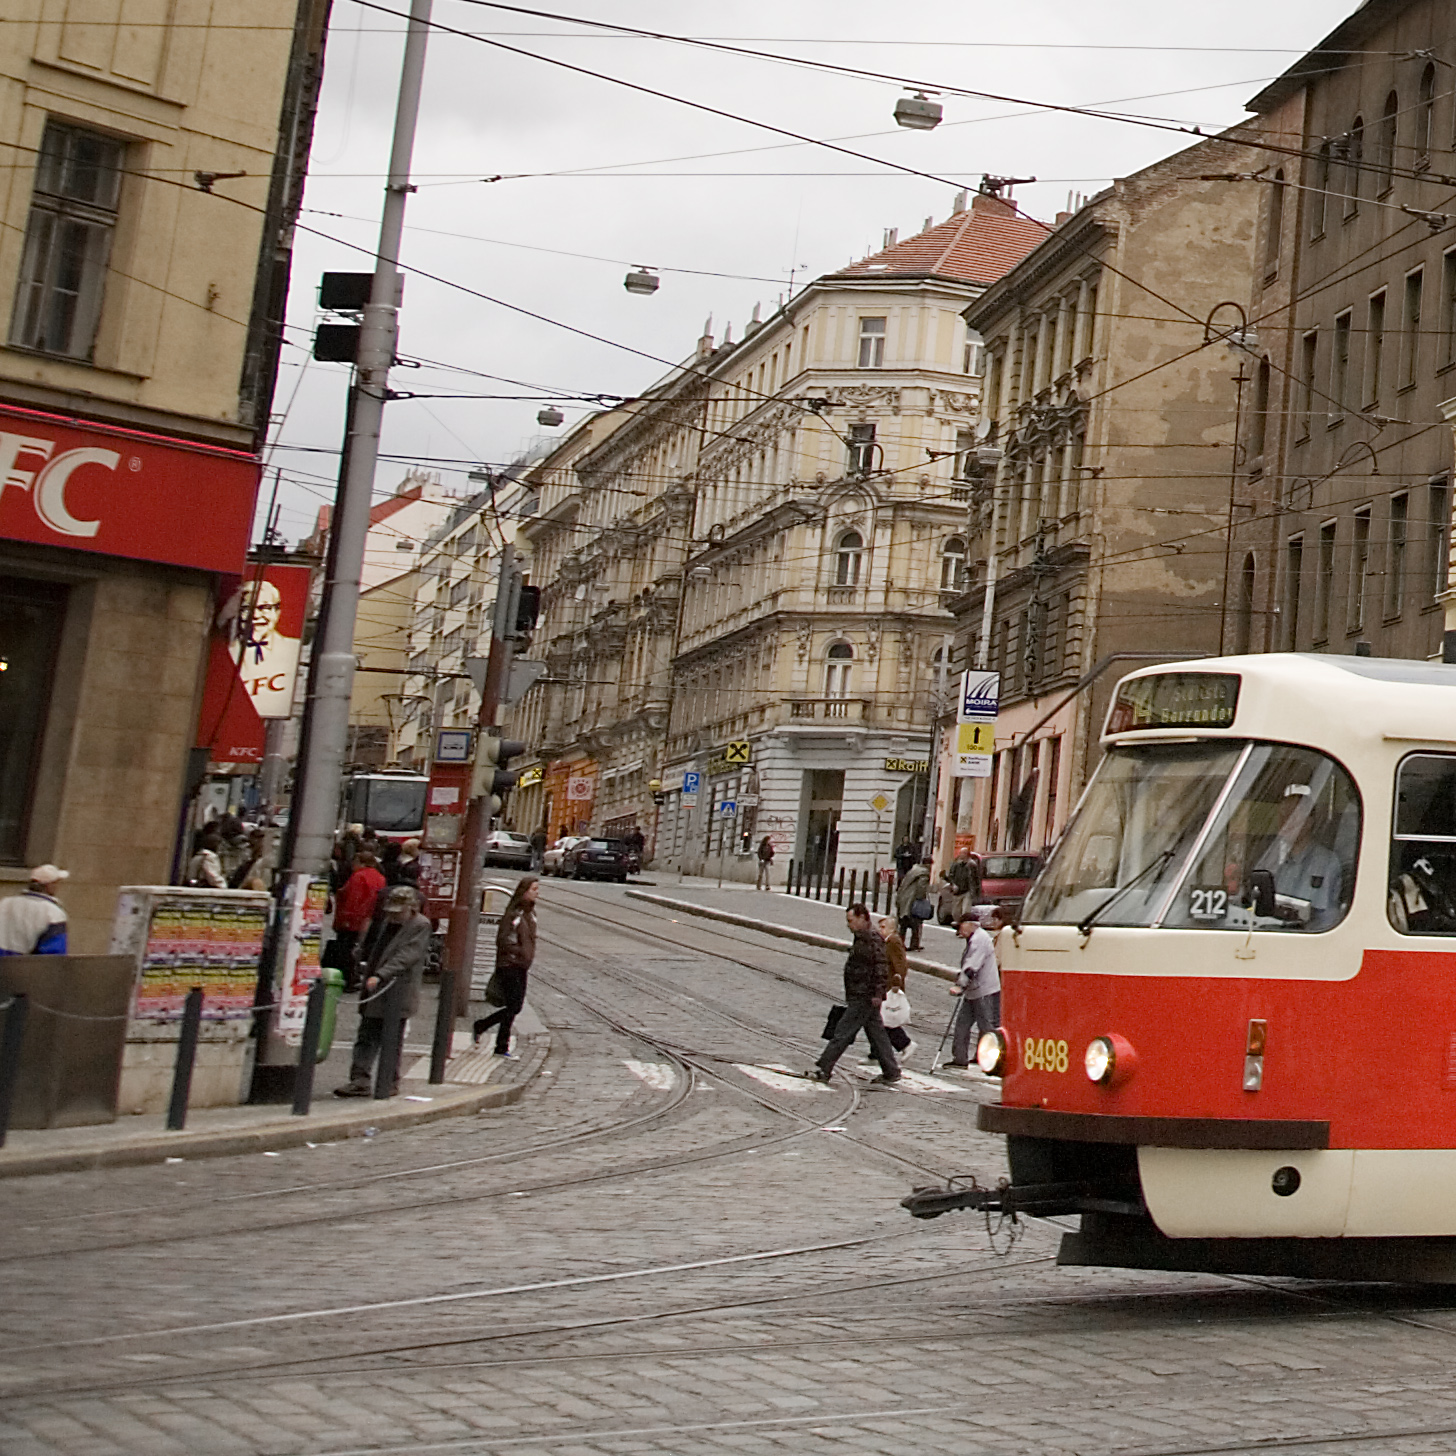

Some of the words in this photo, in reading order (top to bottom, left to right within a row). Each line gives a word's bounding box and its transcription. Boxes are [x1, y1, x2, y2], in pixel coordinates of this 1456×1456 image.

[0, 430, 121, 537] FC
[244, 673, 286, 696] FC
[966, 698, 998, 707] MOIRA
[1189, 889, 1228, 915] 212
[1024, 1037, 1069, 1073] 8498
